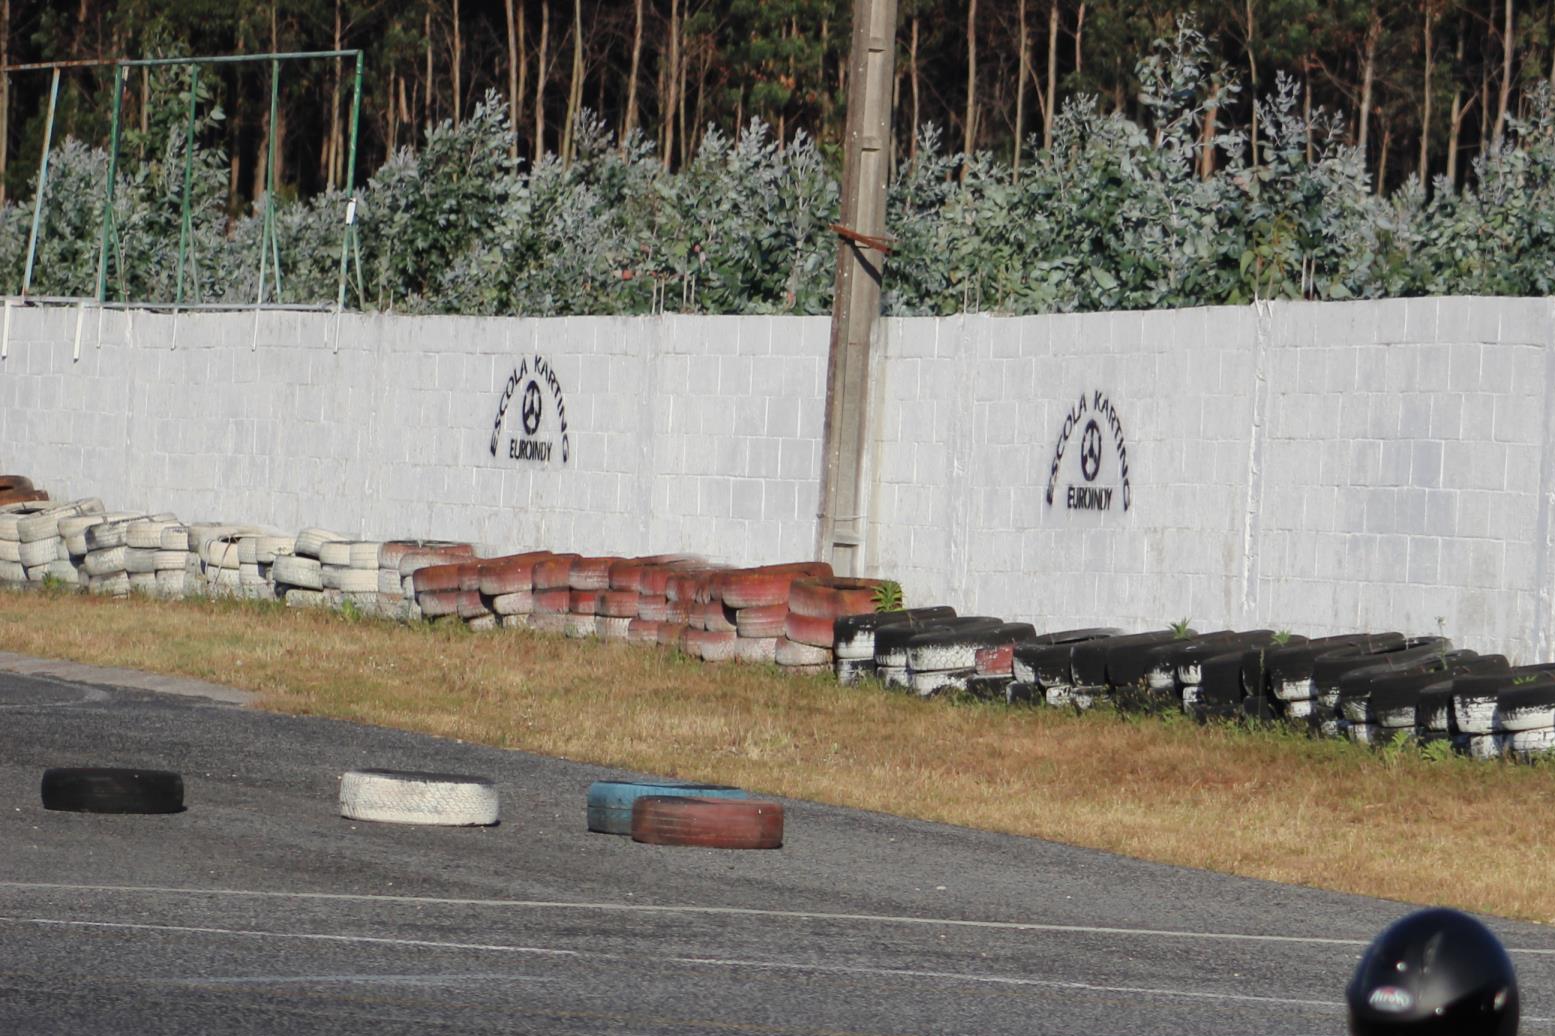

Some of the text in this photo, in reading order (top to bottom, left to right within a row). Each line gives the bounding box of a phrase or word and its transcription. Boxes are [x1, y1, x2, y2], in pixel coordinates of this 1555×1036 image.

[490, 354, 570, 463] ESCOLA KARTING
[509, 438, 553, 462] EUROINDY
[1094, 389, 1131, 512] KARTING
[1067, 485, 1113, 511] EUROINDY
